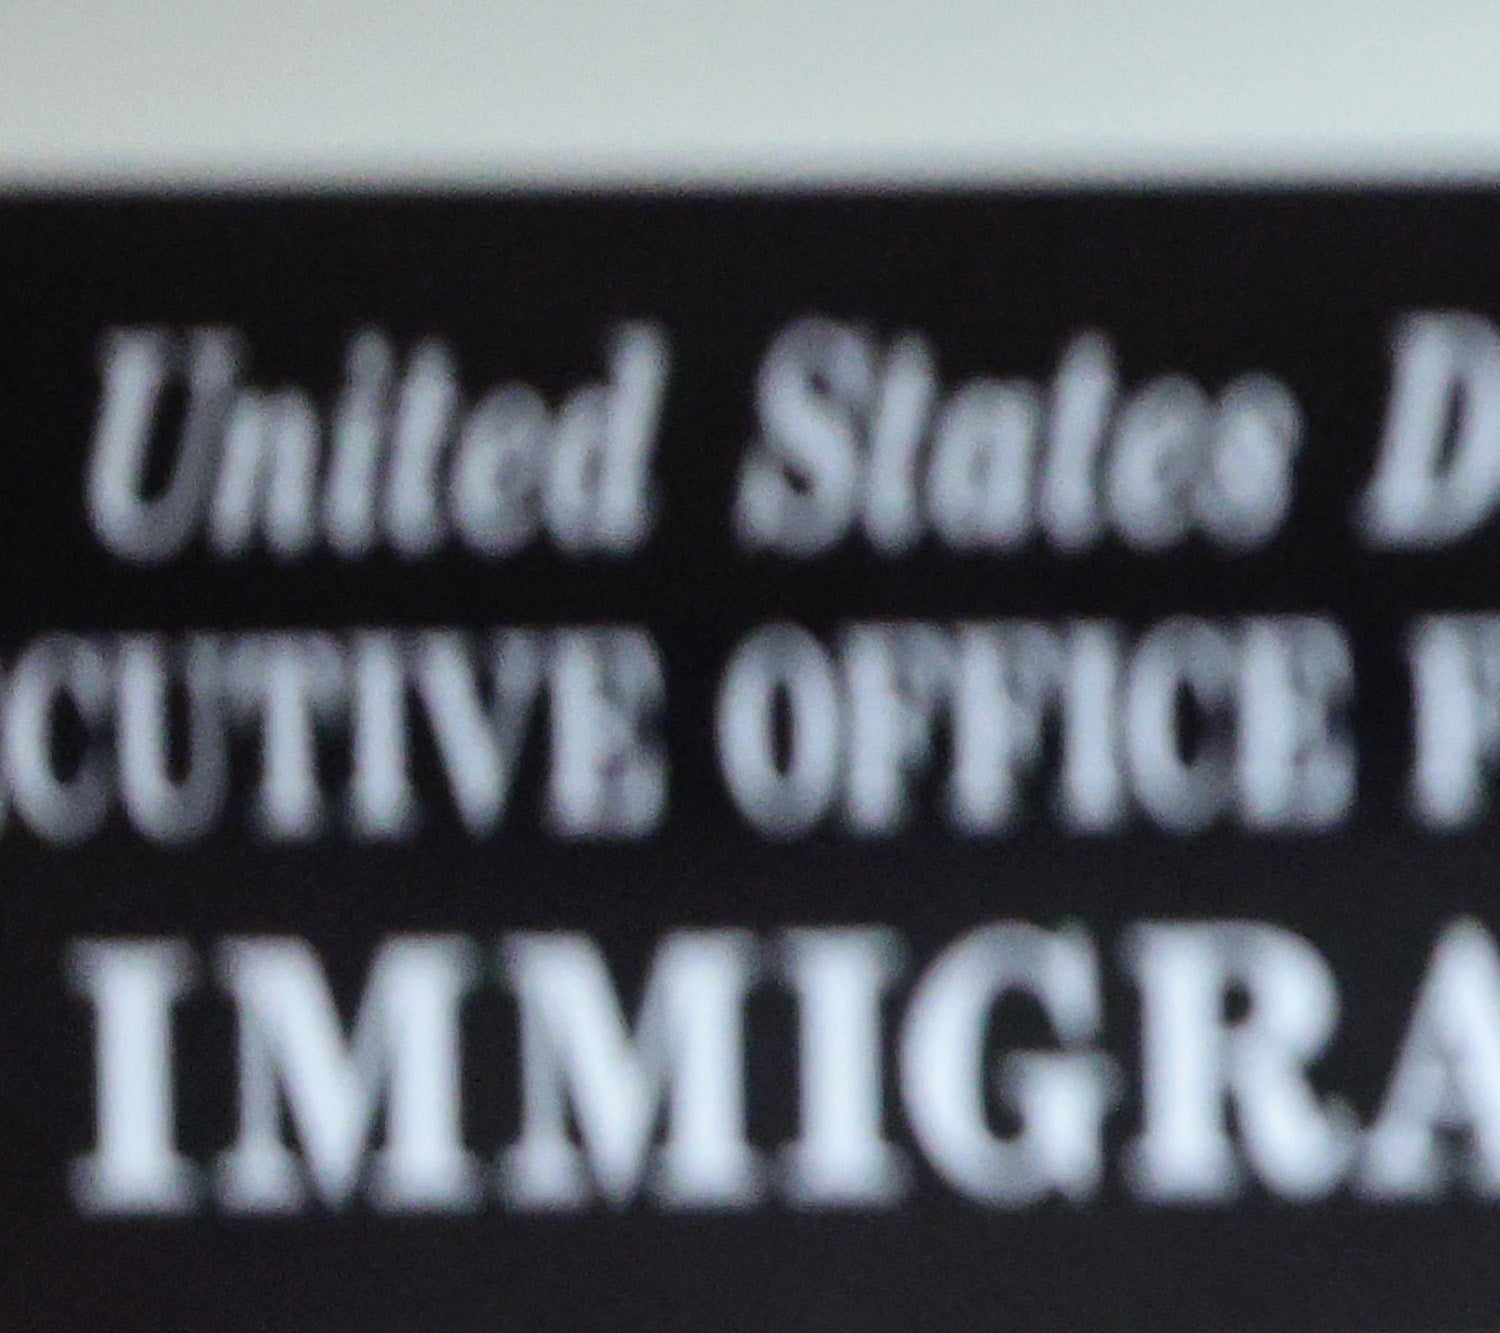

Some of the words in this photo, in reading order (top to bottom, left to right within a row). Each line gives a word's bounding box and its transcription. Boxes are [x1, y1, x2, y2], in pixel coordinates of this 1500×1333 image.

[86, 325, 668, 556] United
[736, 320, 1302, 552] States
[716, 616, 1357, 835] OFFICE
